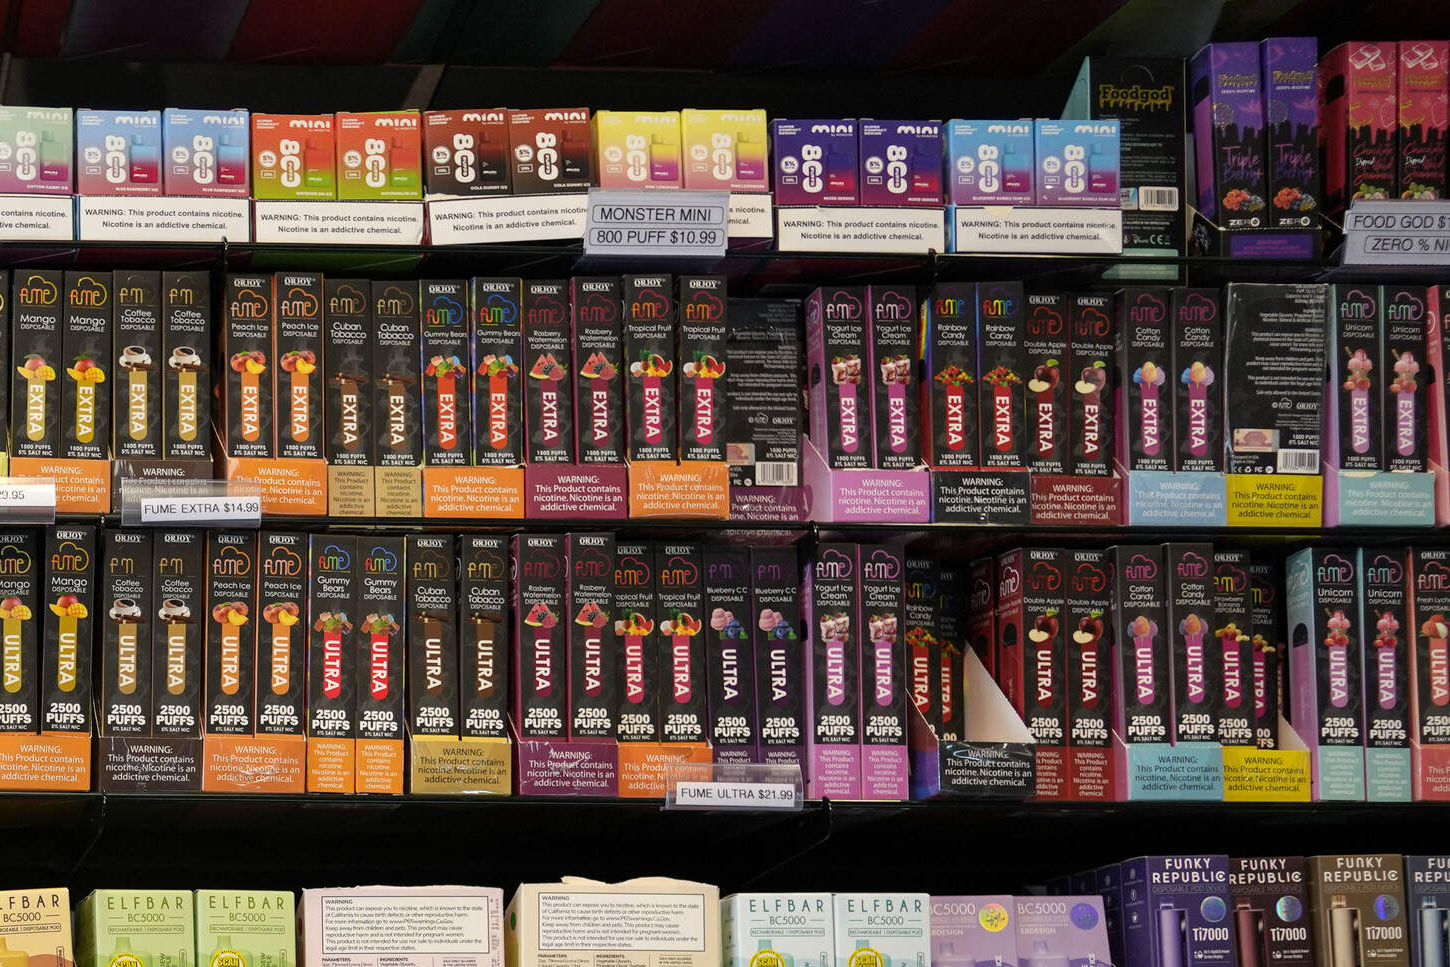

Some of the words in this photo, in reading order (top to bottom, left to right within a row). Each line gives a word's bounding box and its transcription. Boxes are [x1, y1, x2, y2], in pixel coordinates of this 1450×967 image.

[115, 115, 157, 125] mini
[463, 112, 504, 122] mini
[600, 208, 675, 222] MONSTER
[680, 209, 711, 222] MINI
[1279, 216, 1310, 226] ZERO
[1354, 216, 1396, 228] FOOD
[1400, 216, 1434, 228] GOD
[597, 231, 622, 243] 800
[627, 231, 666, 244] PUFF
[670, 231, 716, 245] $10.99
[1372, 238, 1413, 251] ZERO
[1419, 239, 1429, 251] %
[1434, 239, 1450, 250] NI
[947, 395, 962, 451] EXTRA
[144, 504, 176, 515] FUME
[181, 503, 220, 514] EXTRA
[223, 502, 259, 513] $14.99
[51, 577, 87, 587] Mango
[681, 788, 712, 798] FUME
[717, 788, 753, 798] ULTRA
[758, 788, 793, 800] $21.99
[1153, 871, 1226, 884] REPUBLIC
